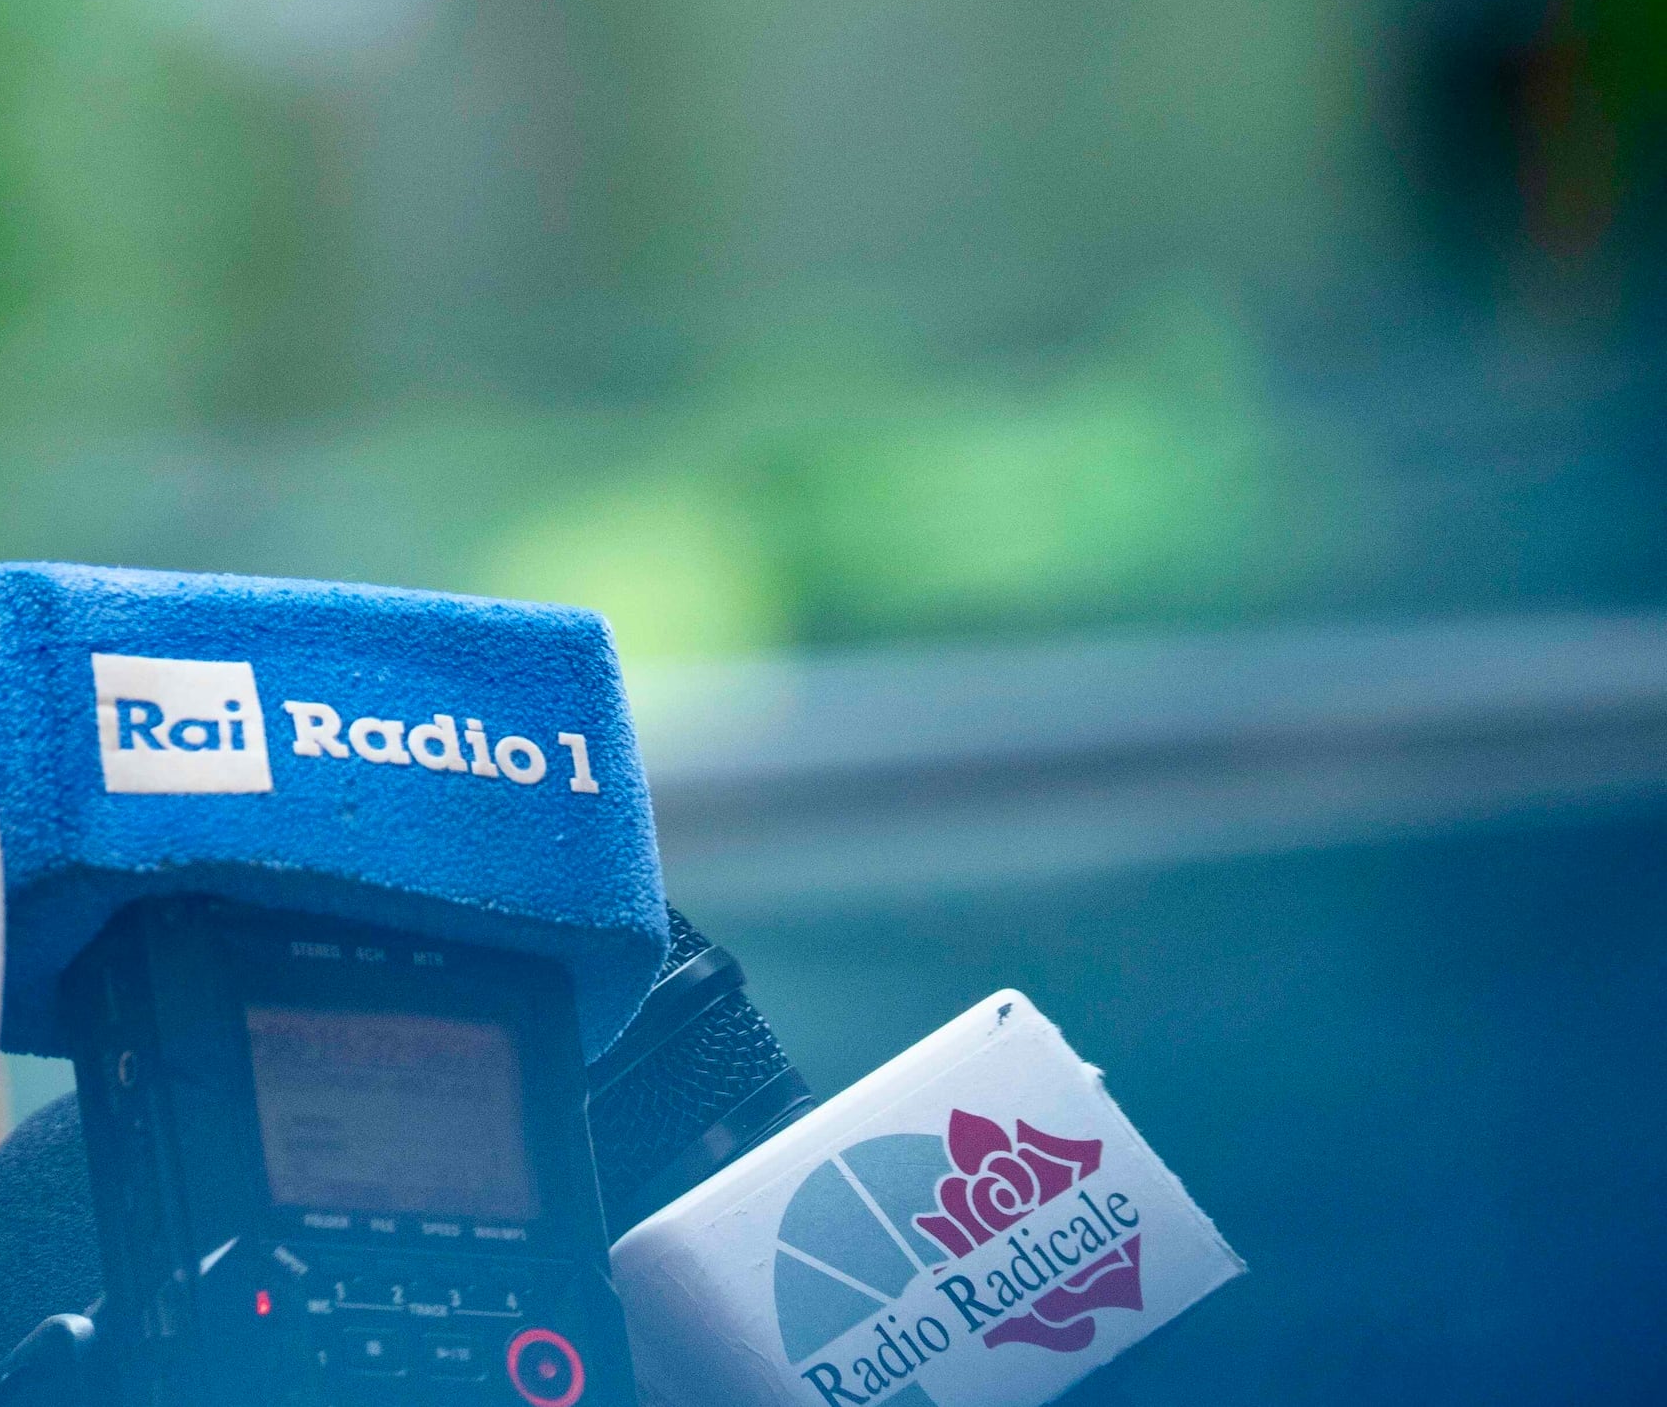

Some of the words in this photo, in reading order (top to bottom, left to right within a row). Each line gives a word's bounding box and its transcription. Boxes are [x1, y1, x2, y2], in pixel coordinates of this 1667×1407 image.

[114, 698, 247, 752] Rai
[282, 701, 547, 786] Radio
[558, 733, 599, 794] 1
[801, 1313, 951, 1407] Radio
[935, 1190, 1140, 1335] Radicale
